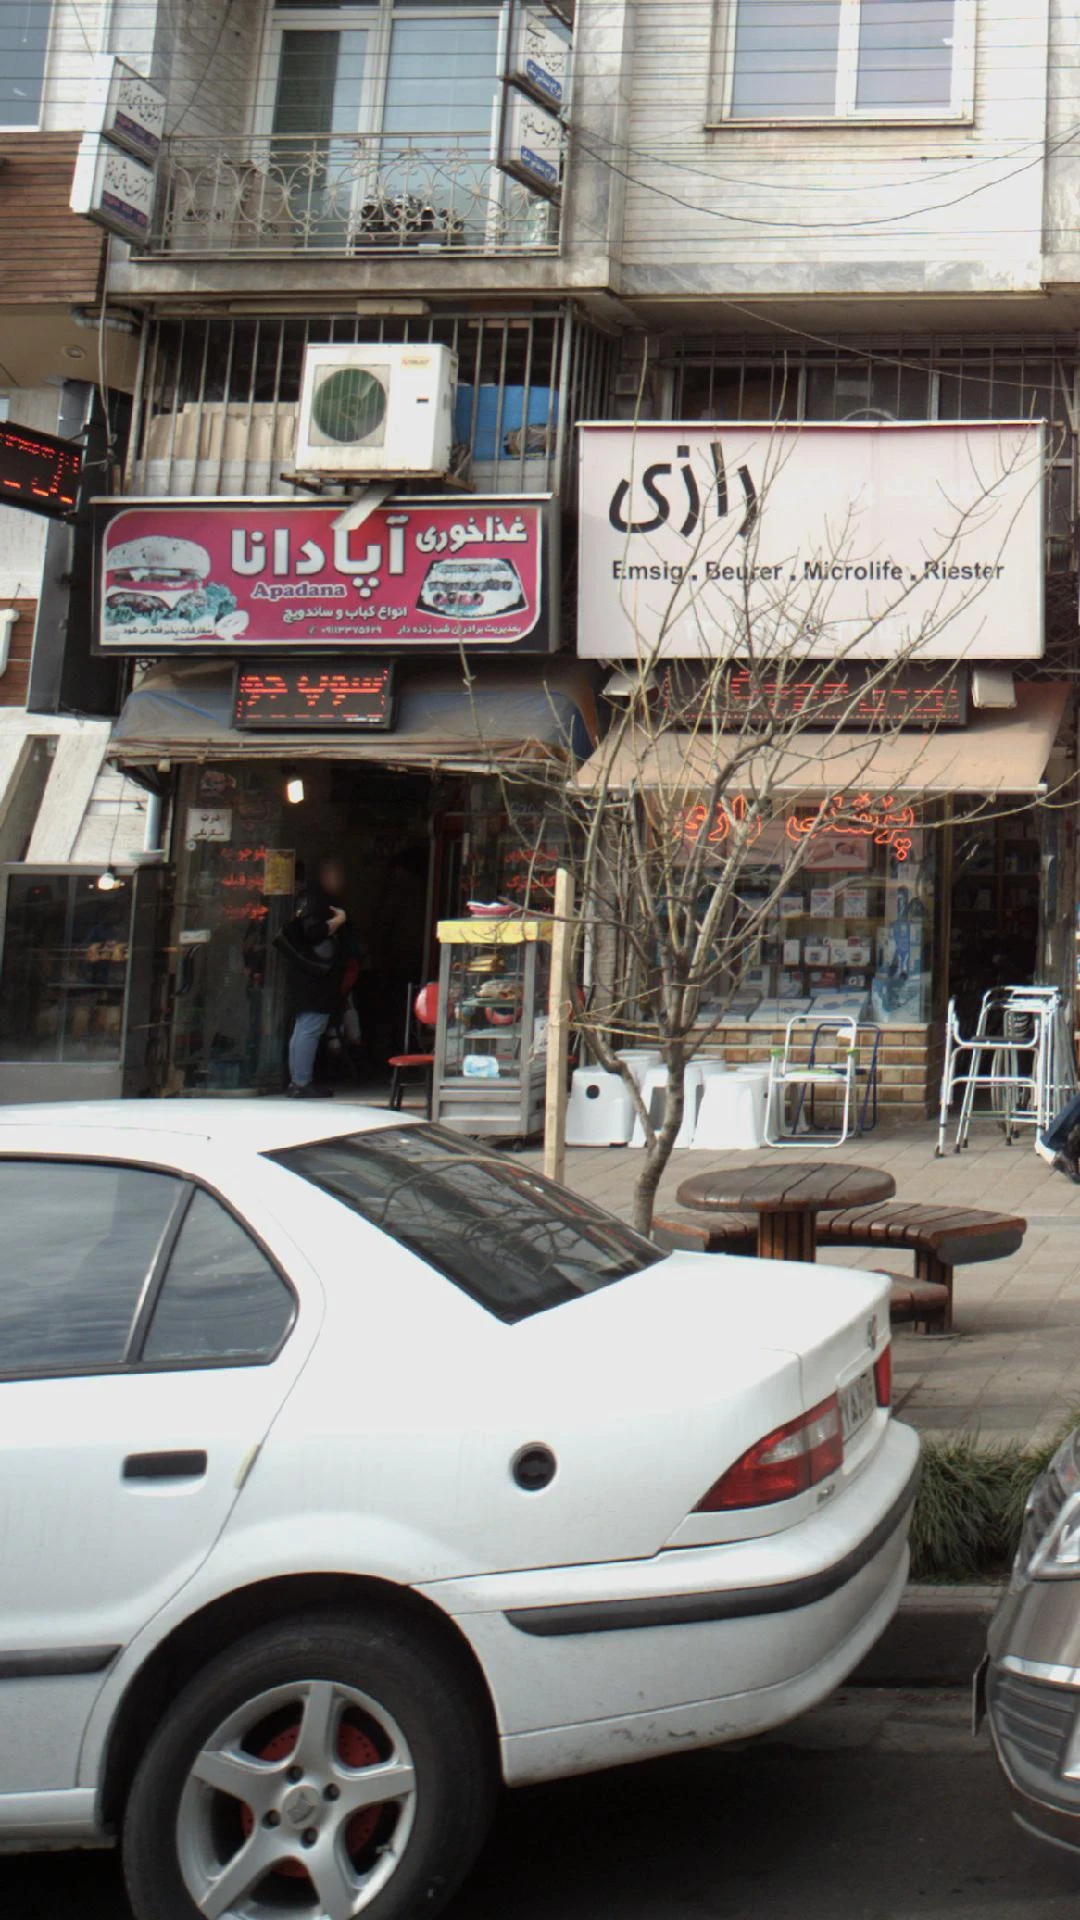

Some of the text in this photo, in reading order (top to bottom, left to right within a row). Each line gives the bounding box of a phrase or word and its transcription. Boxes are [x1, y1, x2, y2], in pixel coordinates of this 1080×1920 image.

[609, 442, 757, 538] رازی
[415, 515, 529, 553] غذاخوری
[230, 515, 409, 598] آپادانا
[612, 560, 1005, 585] Emsig Beurer Microlife Riester
[251, 582, 347, 601] Apadana
[282, 606, 408, 623] انواع کباب و ساندویچ
[786, 793, 915, 860] پزشکی
